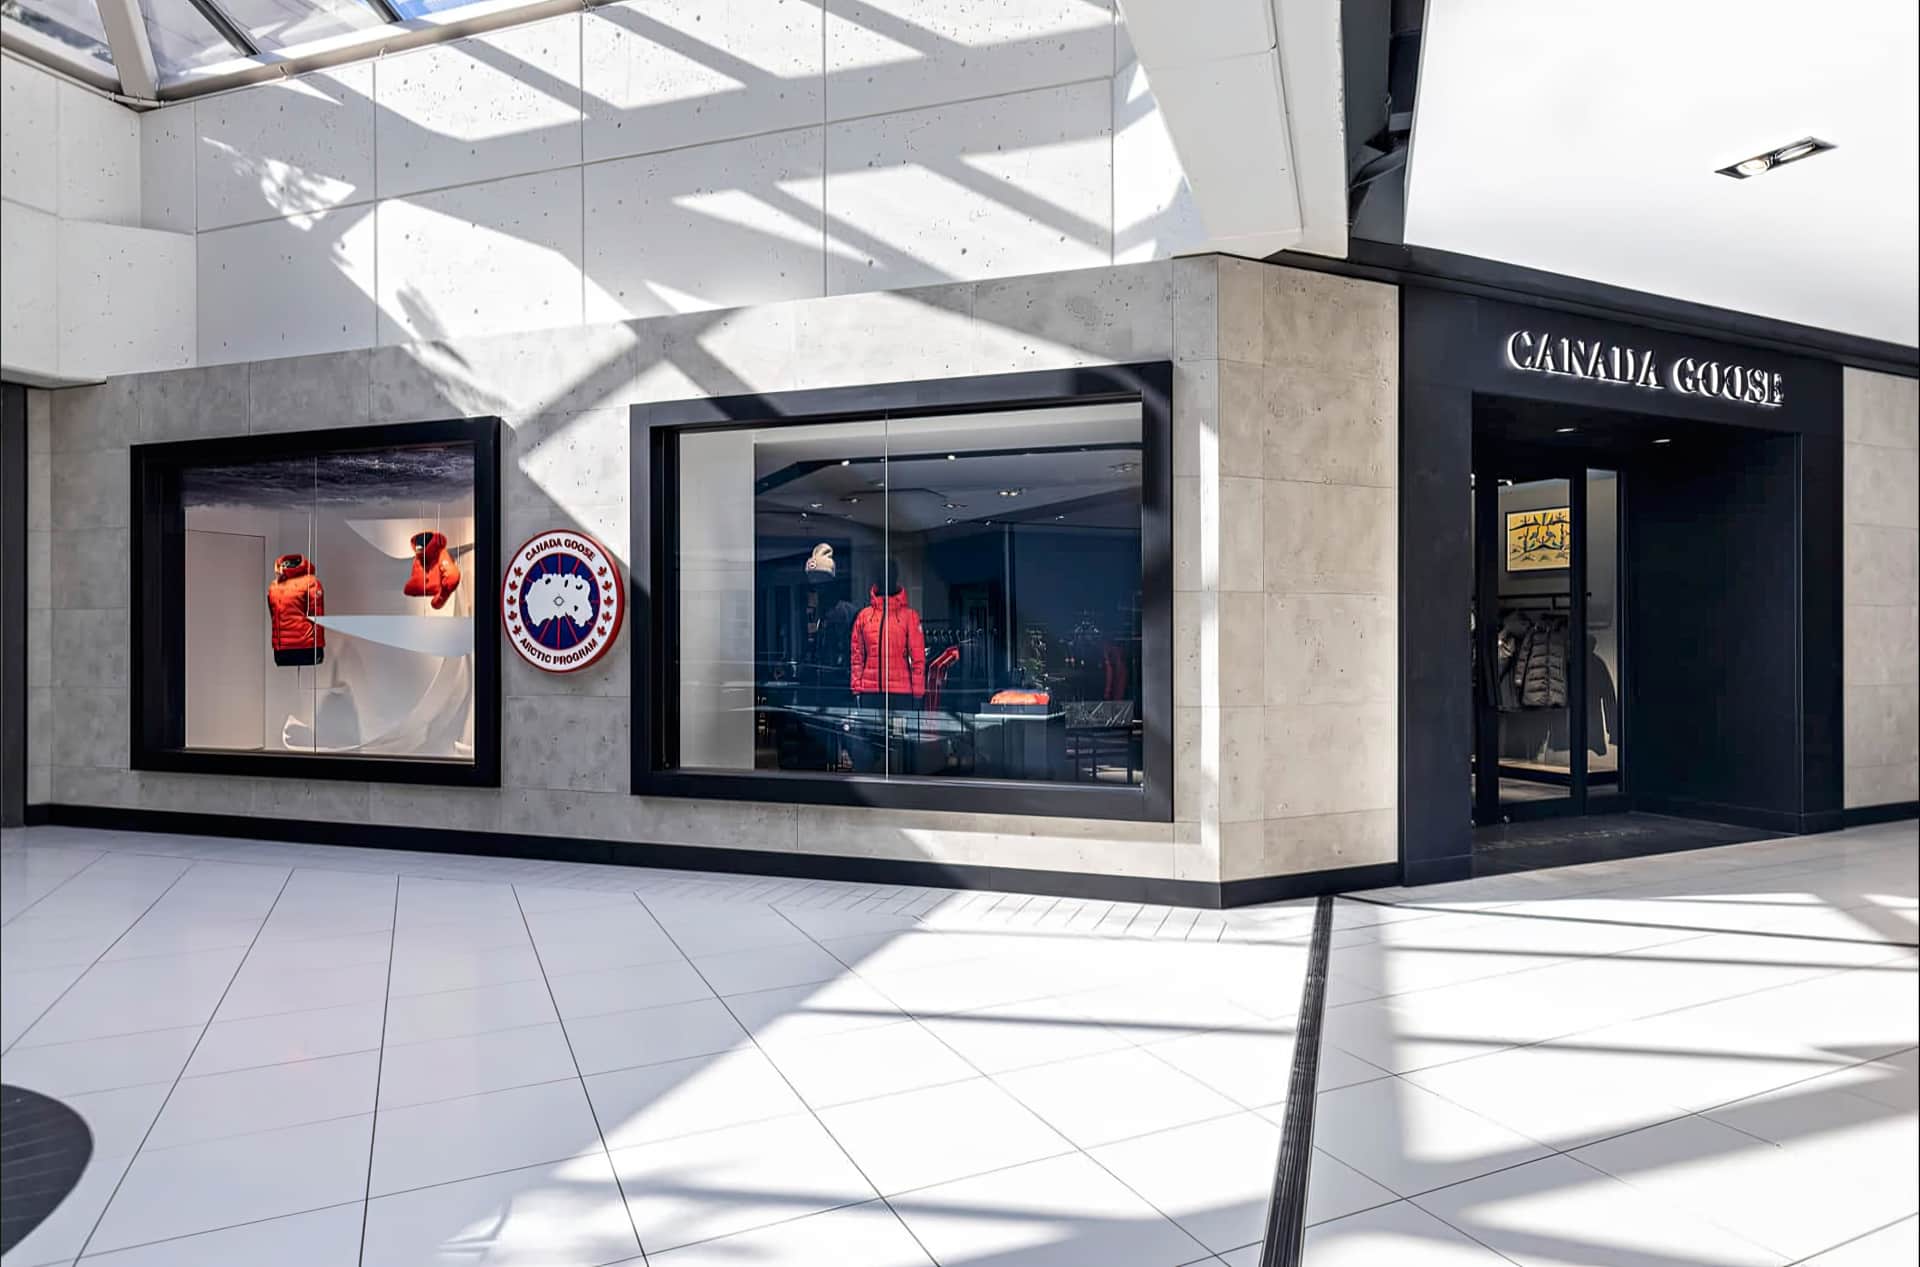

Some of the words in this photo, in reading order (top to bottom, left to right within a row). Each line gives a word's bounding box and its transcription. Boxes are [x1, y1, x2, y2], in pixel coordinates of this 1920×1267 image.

[1506, 330, 1664, 389] CANADA
[1672, 356, 1784, 406] GOOSE
[525, 538, 562, 561] CANADA
[564, 538, 596, 562] GOOSE
[520, 638, 551, 664] ARCTIC
[553, 639, 599, 665] PROGRAM
